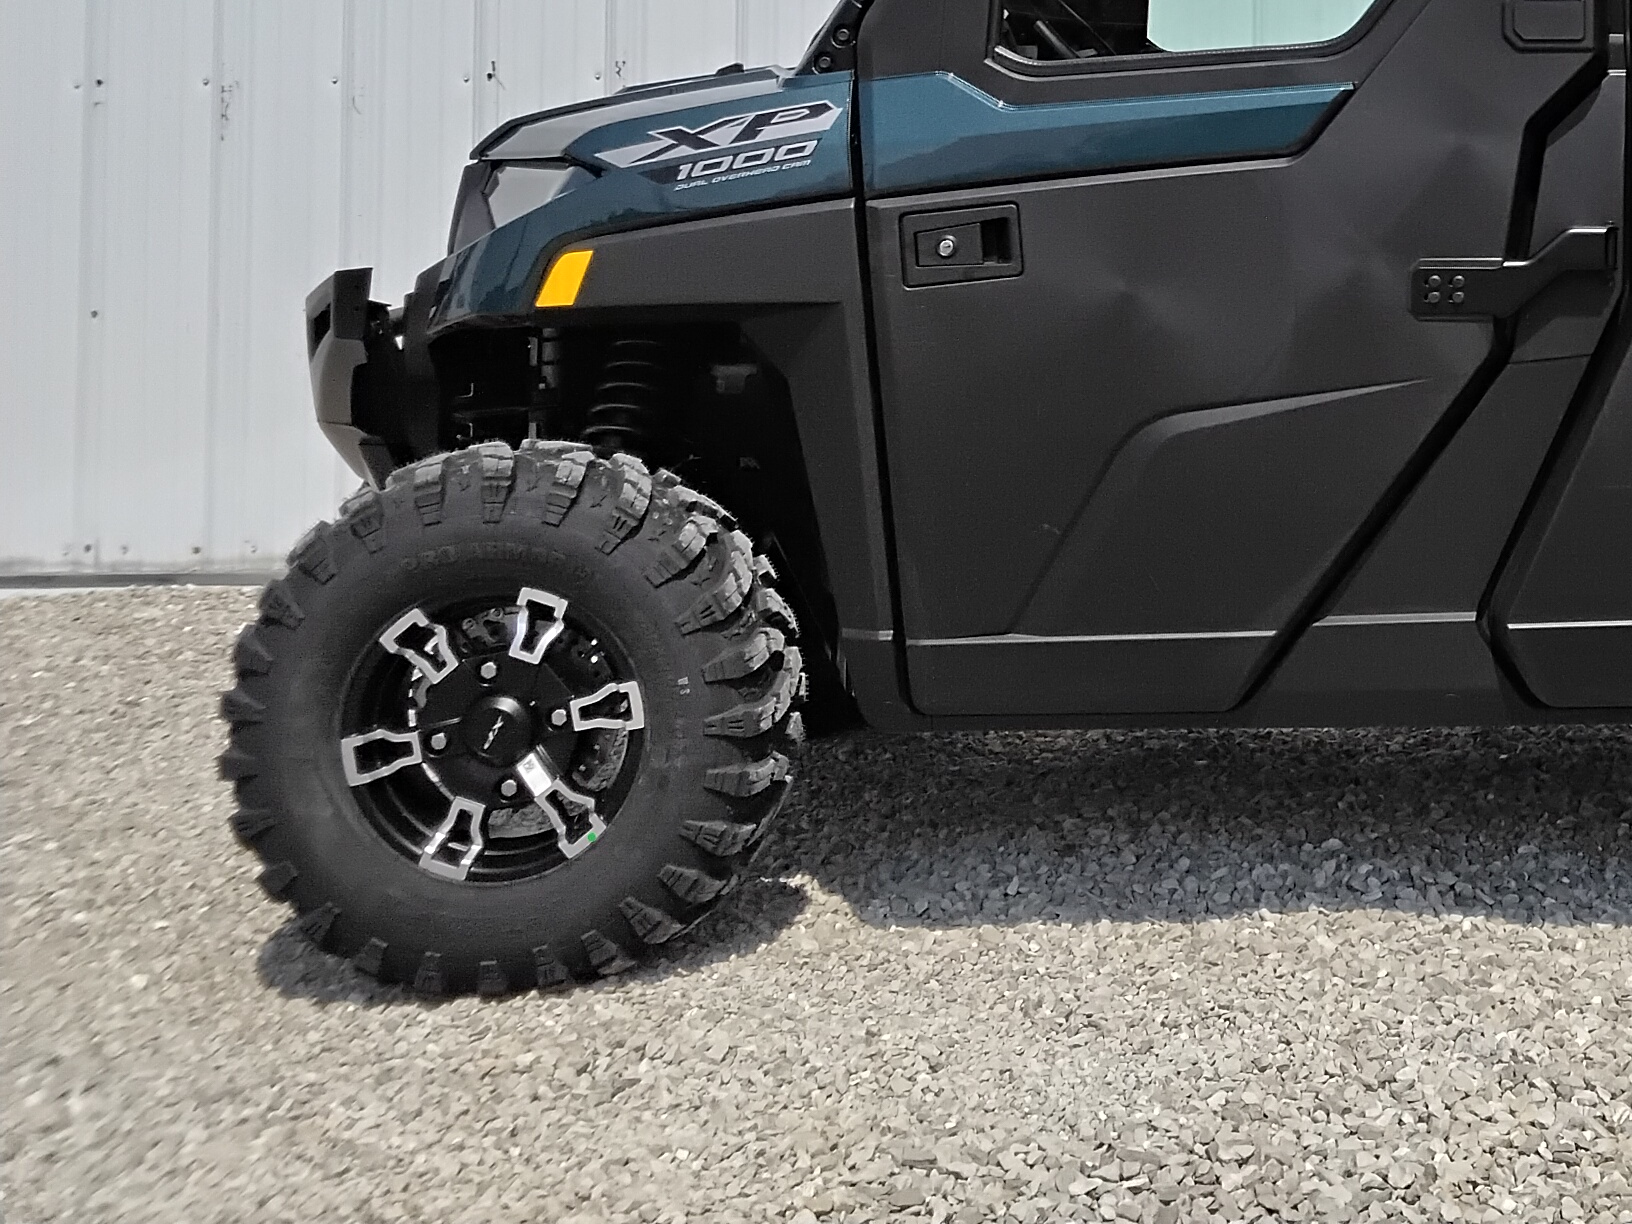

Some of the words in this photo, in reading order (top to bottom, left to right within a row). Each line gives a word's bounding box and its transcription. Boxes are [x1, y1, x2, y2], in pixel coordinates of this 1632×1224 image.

[624, 101, 836, 165] XP
[673, 178, 709, 192] DUAL
[711, 165, 781, 184] OVERHEAD
[781, 159, 812, 171] CAM
[676, 139, 819, 181] 1000
